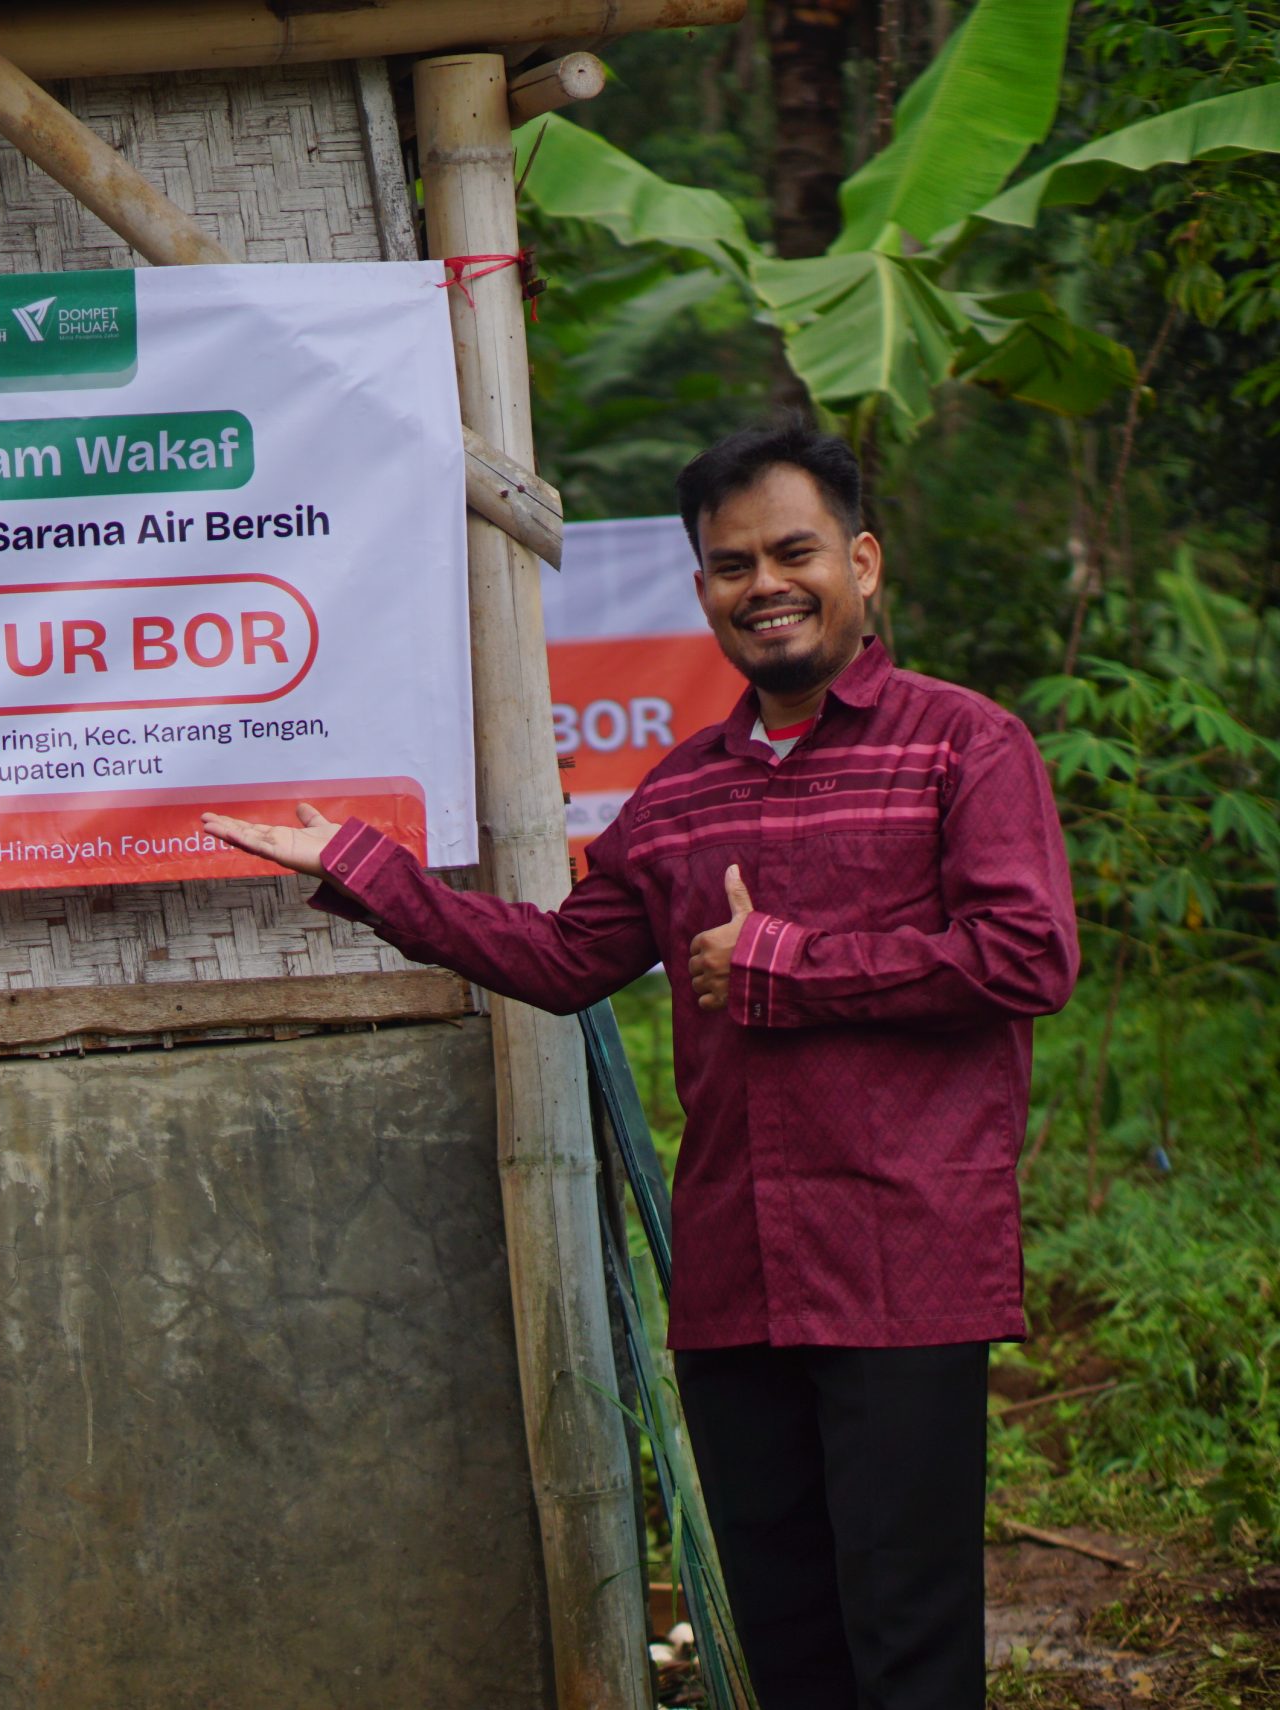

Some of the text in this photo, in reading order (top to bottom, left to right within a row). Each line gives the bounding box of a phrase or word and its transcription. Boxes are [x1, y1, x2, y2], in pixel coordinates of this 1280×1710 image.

[59, 307, 119, 321] DOMPET
[59, 321, 119, 335] DHUAFA
[75, 427, 239, 475] Wakaf
[137, 510, 194, 544] Air
[205, 504, 330, 542] Bersih
[131, 610, 289, 671] BOR
[84, 727, 137, 748] Kec.
[144, 722, 233, 746] Karang
[238, 718, 329, 742] Tengan,
[551, 696, 675, 754] BOR
[93, 757, 163, 777] Garut
[121, 831, 235, 856] Foundat
